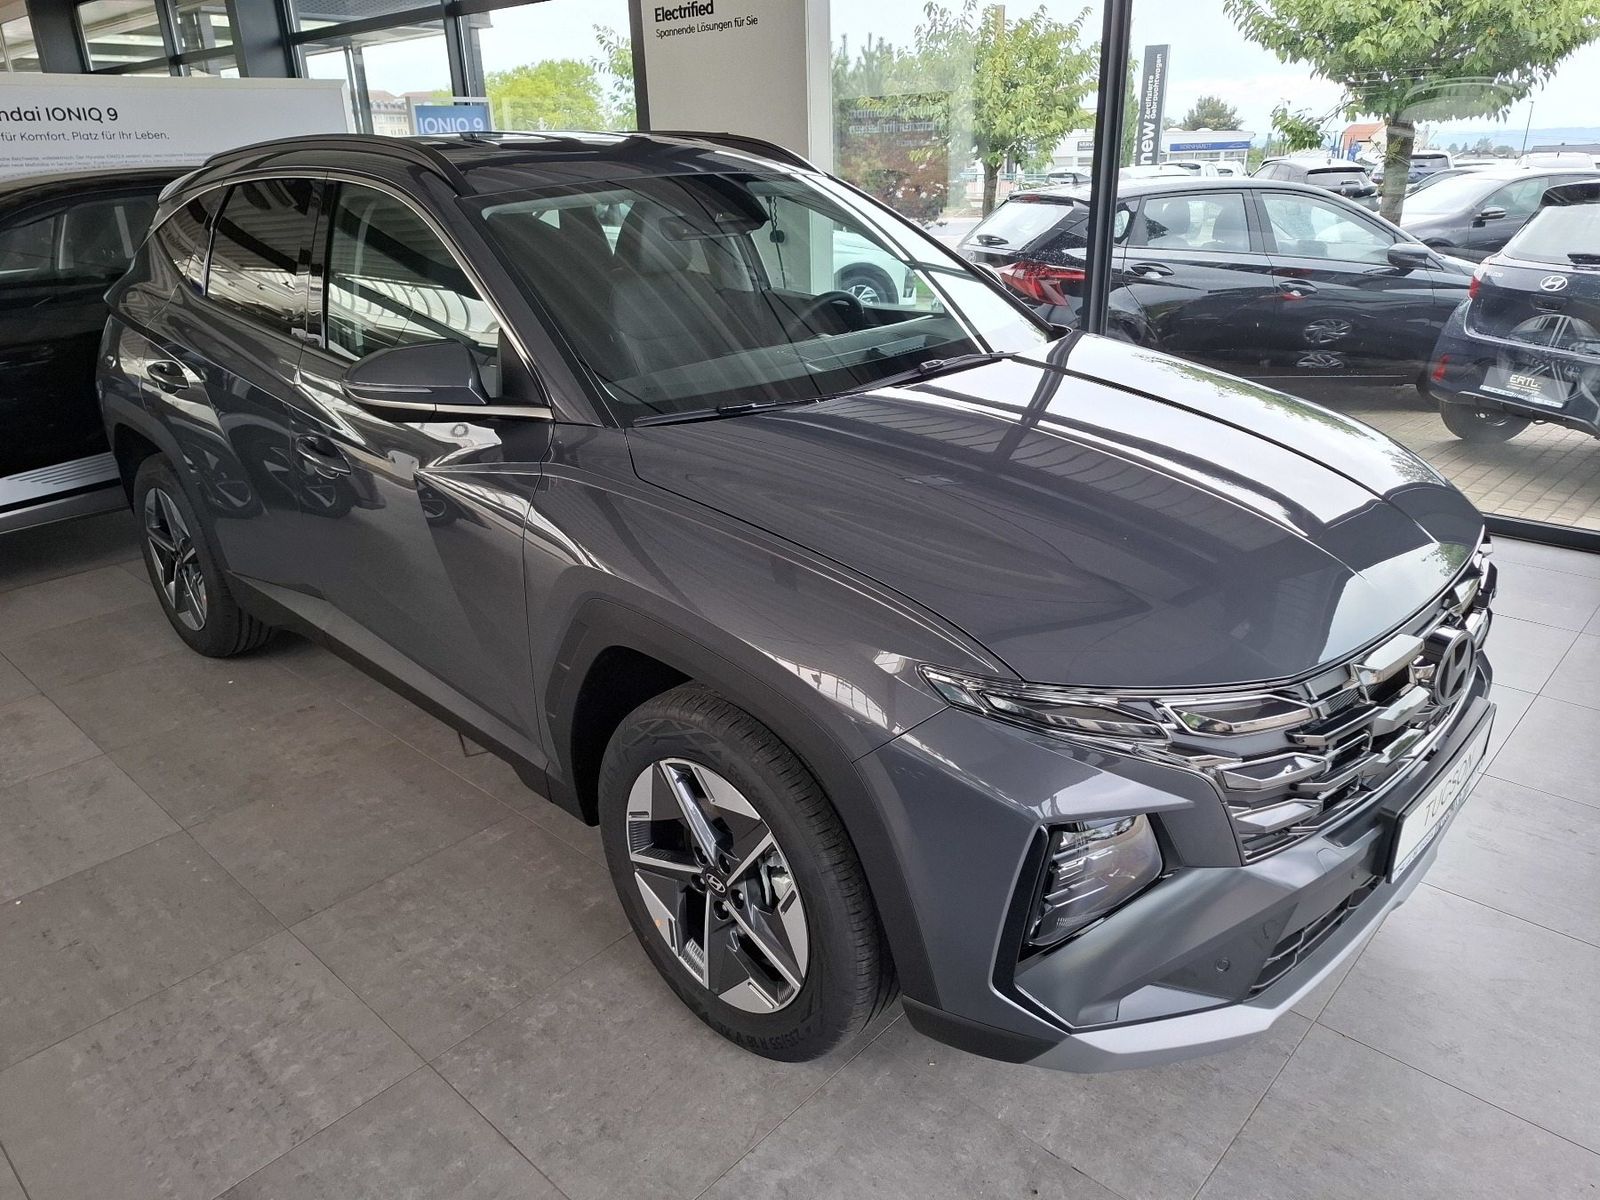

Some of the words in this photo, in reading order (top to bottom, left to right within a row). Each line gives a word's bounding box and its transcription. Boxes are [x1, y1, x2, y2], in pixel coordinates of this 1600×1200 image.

[654, 0, 714, 22] Electrified
[656, 24, 696, 39] Spannende
[696, 20, 733, 32] Lösungen
[734, 16, 745, 27] für
[746, 14, 759, 26] Sie
[1144, 75, 1154, 119] Zertifizierte
[1150, 54, 1162, 119] Gebrauchtwagen
[45, 107, 103, 123] IONIQ
[106, 107, 118, 121] 9
[473, 117, 484, 131] 9
[0, 131, 16, 141] für
[20, 131, 70, 141] Komfort.
[72, 131, 99, 140] Platz
[102, 130, 116, 140] für
[118, 130, 132, 140] Ihr
[135, 130, 170, 140] Leben.
[1140, 121, 1155, 165] new
[1509, 374, 1538, 387] ERTL
[1424, 746, 1477, 826] TUCSON
